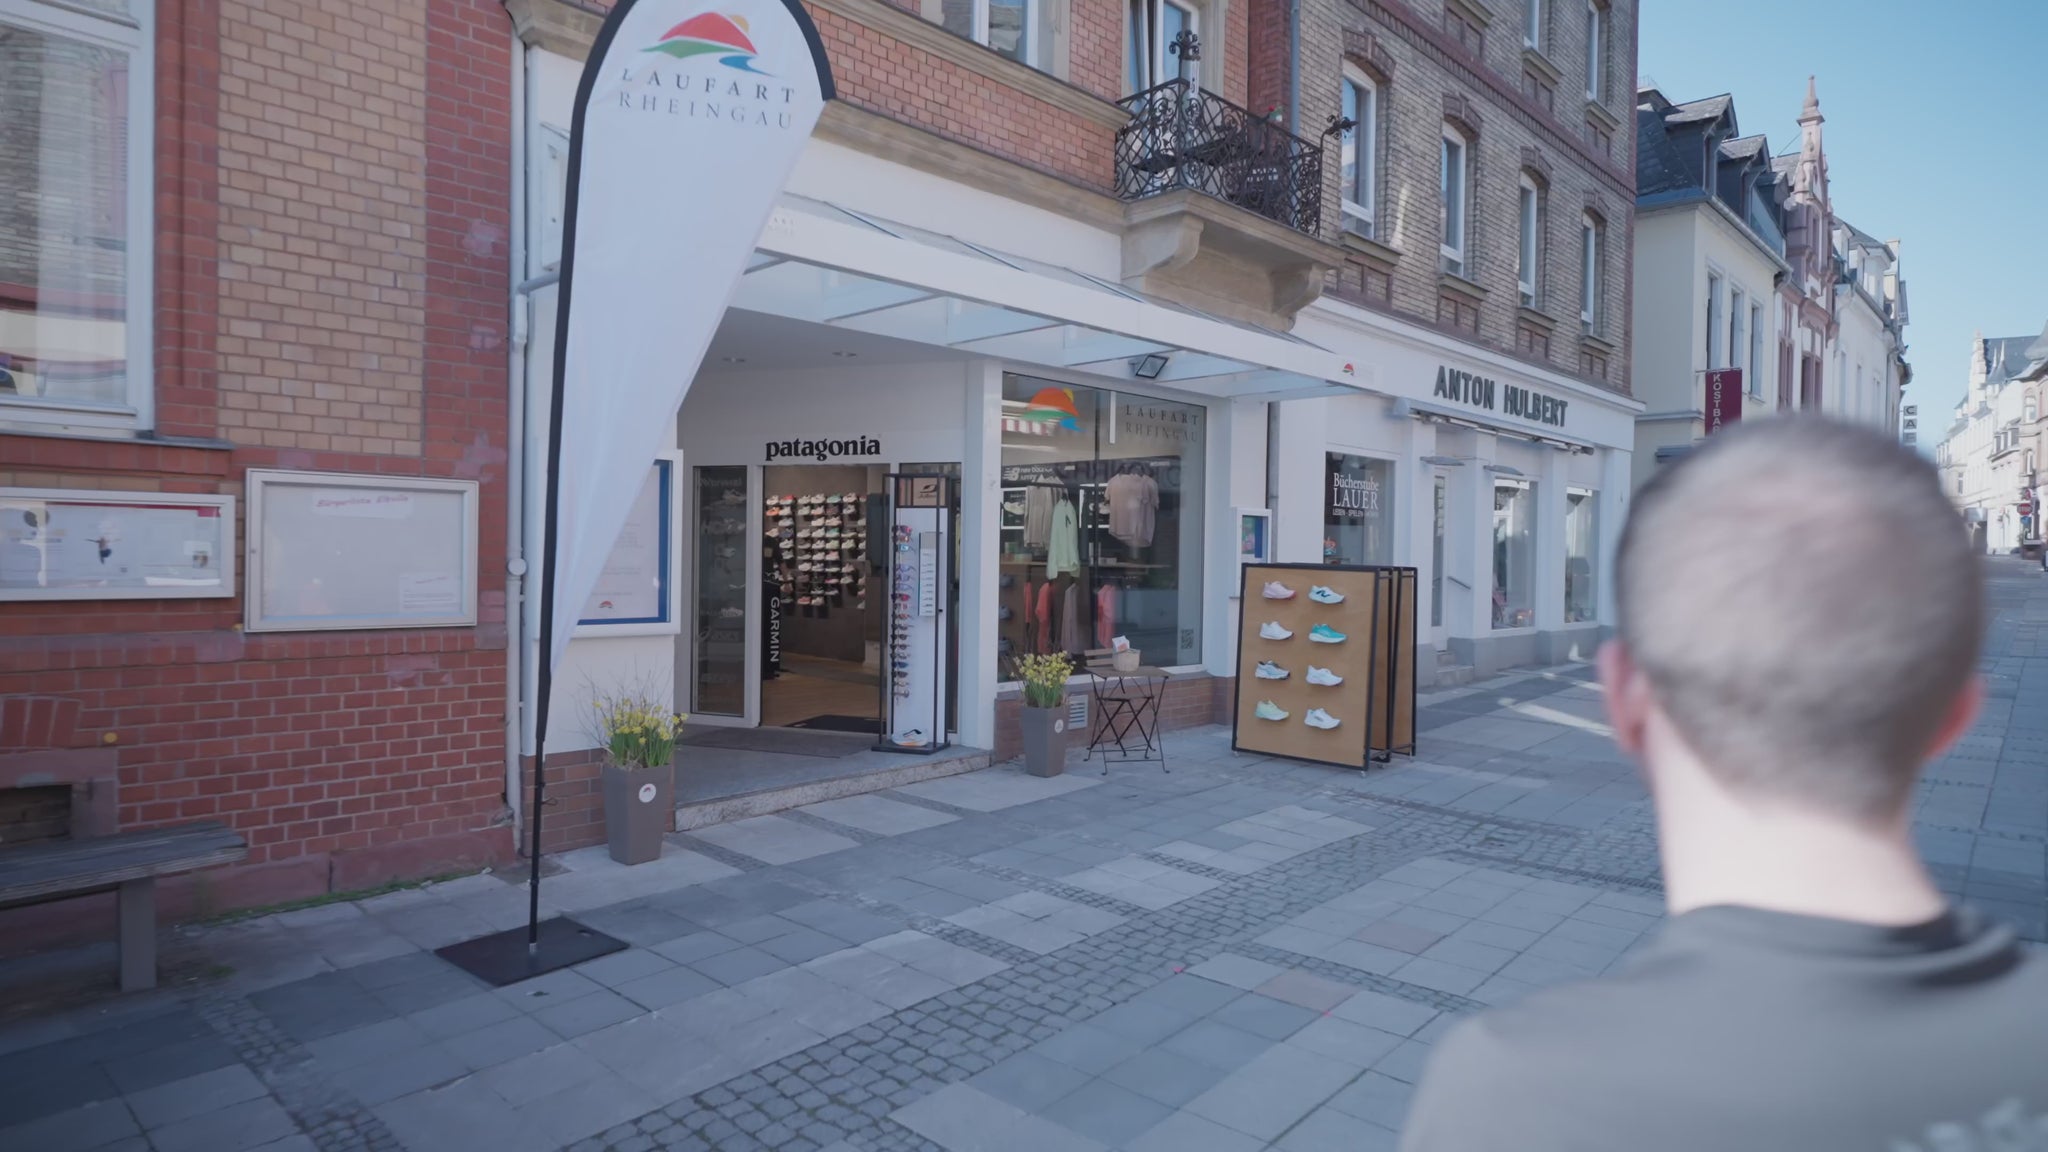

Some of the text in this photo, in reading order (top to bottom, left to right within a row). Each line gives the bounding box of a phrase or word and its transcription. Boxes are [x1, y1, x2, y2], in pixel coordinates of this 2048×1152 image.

[622, 68, 795, 103] LAUFART
[619, 91, 792, 130] RHEINGAU
[1434, 365, 1568, 427] ANTON HULBERT
[1126, 404, 1199, 425] LAUFART
[1126, 422, 1198, 442] RHEINGAU
[765, 435, 881, 461] patagonia
[1333, 472, 1379, 491] Bücherstube
[1333, 487, 1379, 510] LAUER
[770, 596, 780, 662] GARMIN
